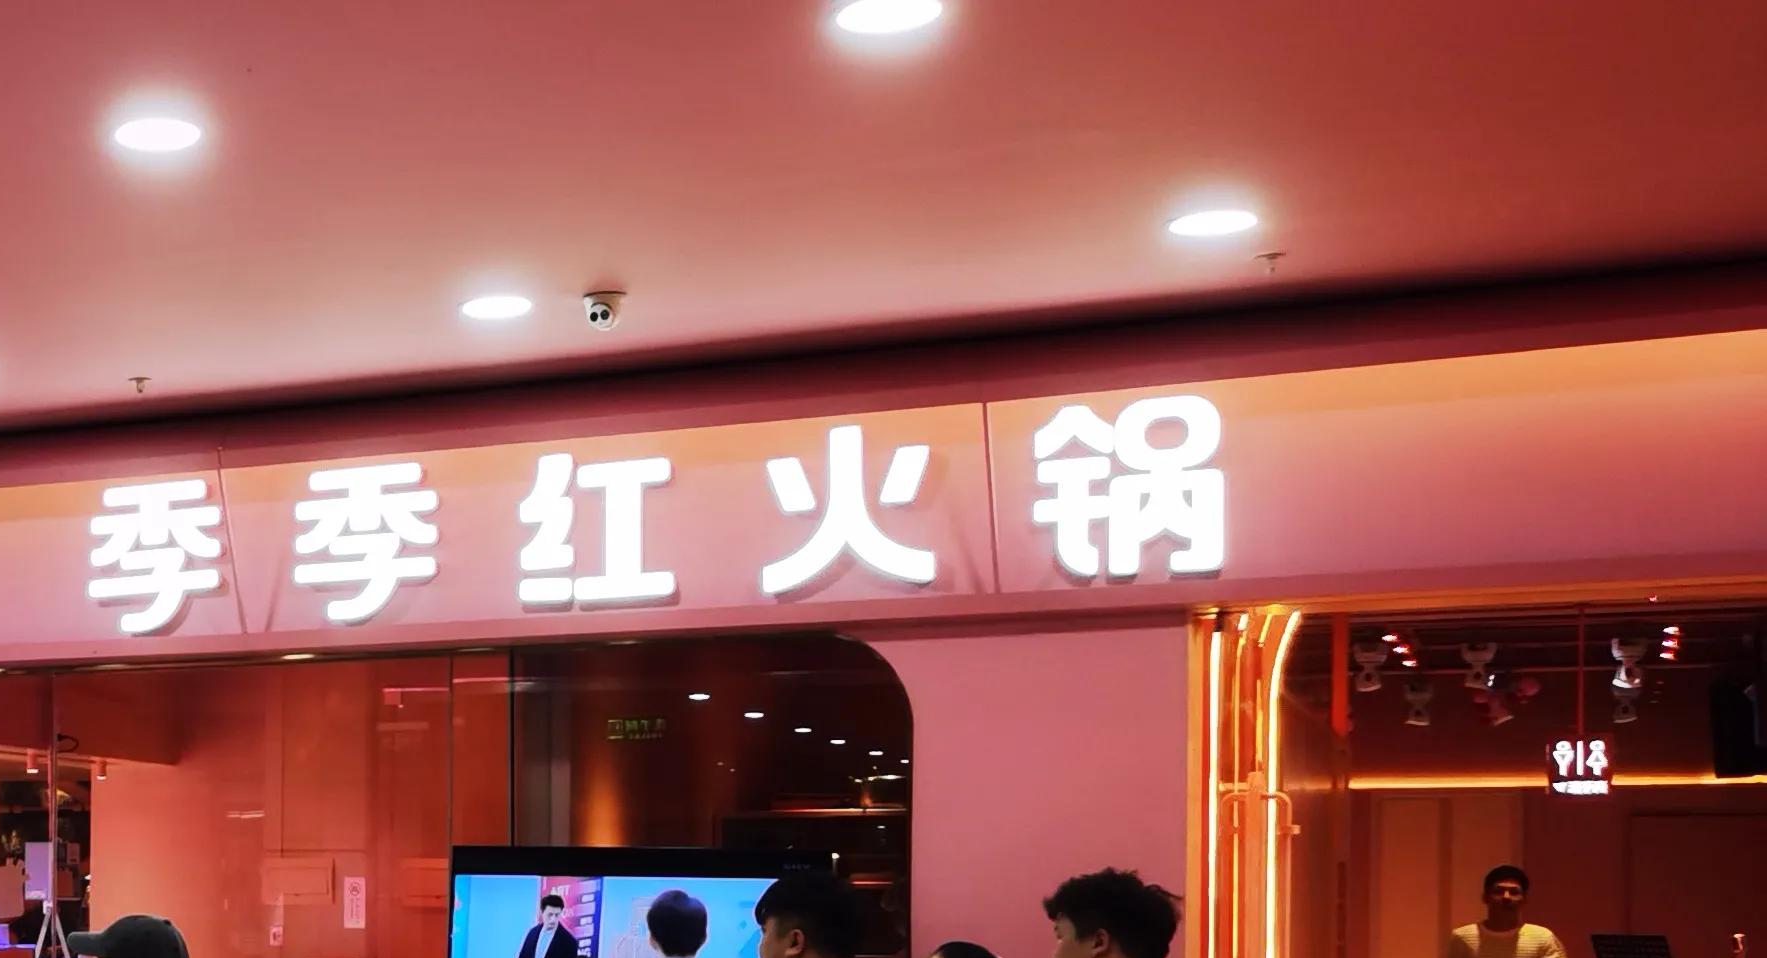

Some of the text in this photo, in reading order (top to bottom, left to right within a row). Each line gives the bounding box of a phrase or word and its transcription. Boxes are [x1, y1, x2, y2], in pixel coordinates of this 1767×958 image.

[87, 394, 1227, 633] 季季红火锅
